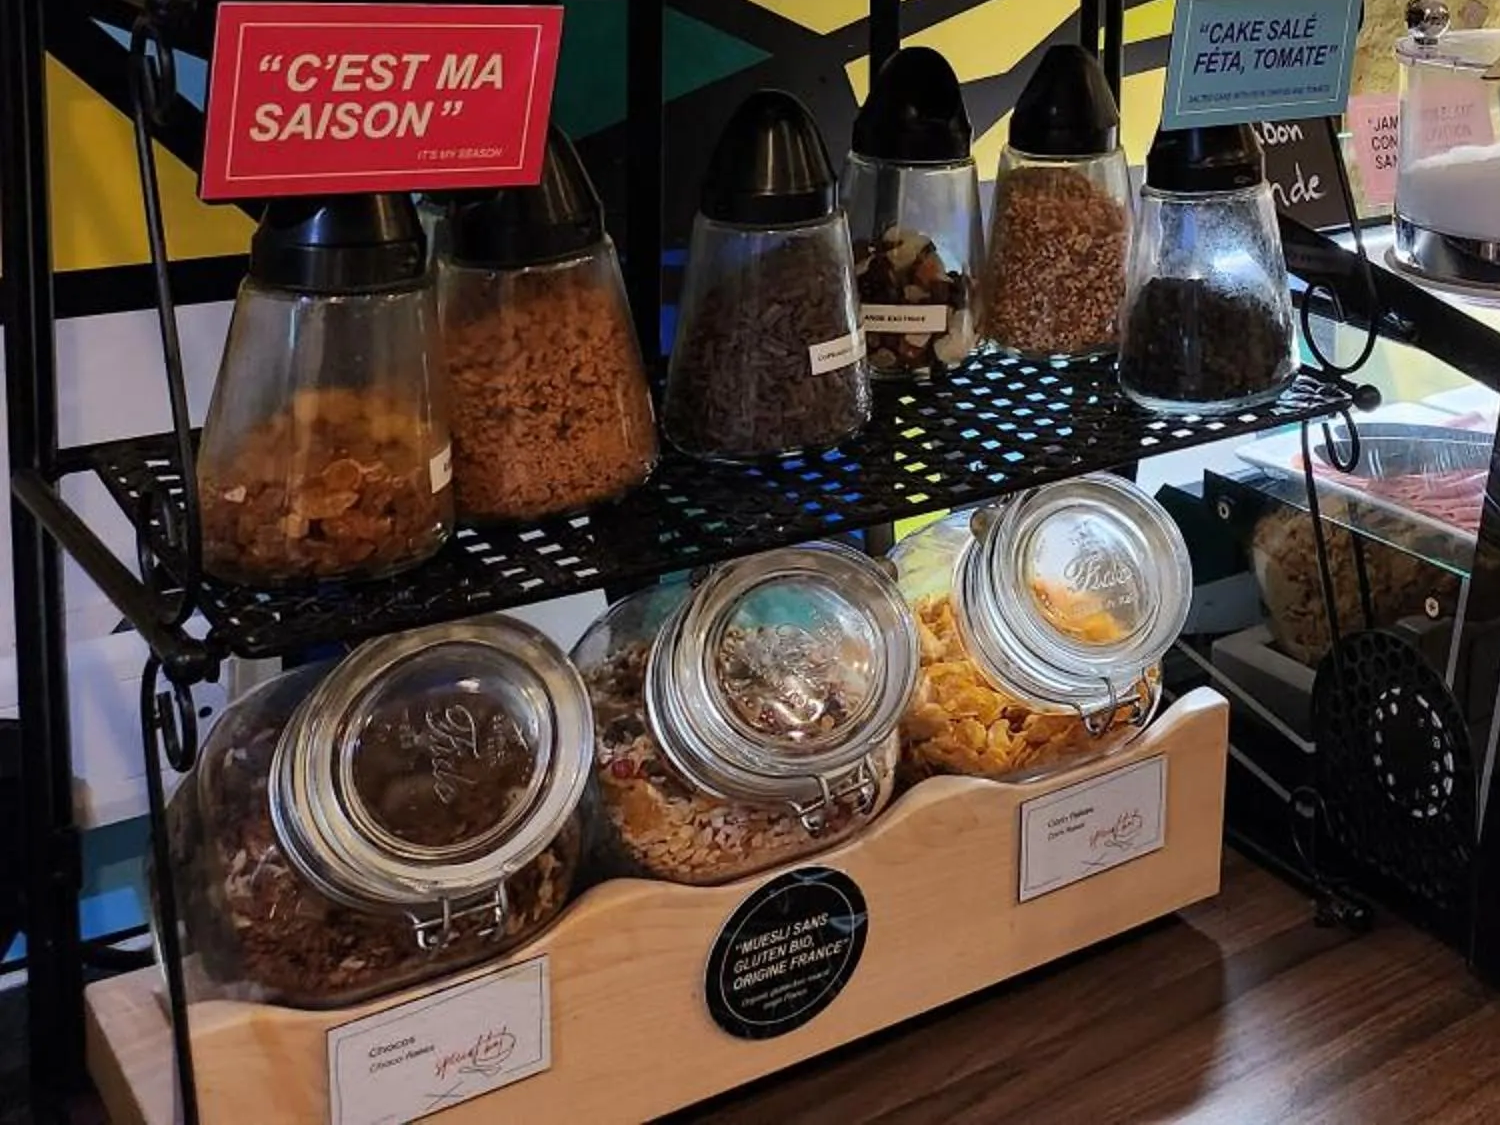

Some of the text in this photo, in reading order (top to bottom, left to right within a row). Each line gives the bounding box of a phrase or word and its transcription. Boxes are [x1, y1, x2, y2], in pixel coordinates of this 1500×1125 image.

[1267, 14, 1317, 41] SALÉ
[258, 53, 505, 93] "C'EST MA
[1269, 162, 1327, 207] nde
[792, 912, 830, 937] SANS
[733, 959, 788, 992] ORIGINE
[734, 944, 787, 975] GLUTEN
